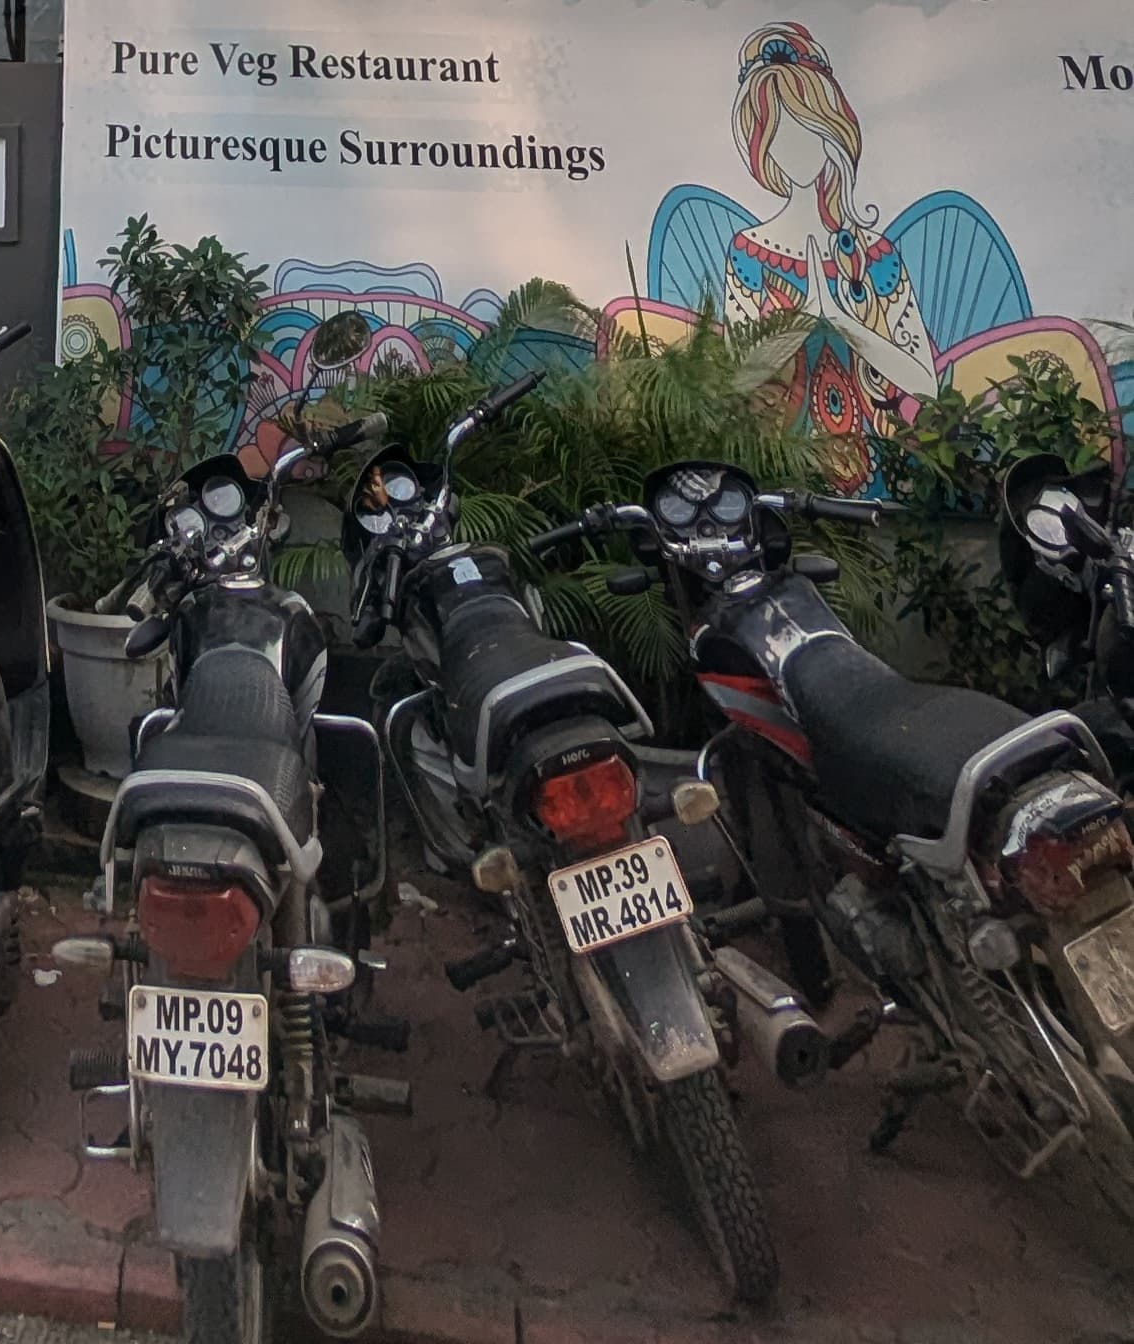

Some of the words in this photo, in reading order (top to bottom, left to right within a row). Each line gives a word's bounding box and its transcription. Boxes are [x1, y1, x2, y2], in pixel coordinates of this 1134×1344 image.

[112, 41, 199, 77] Pure
[210, 43, 278, 87] Veg
[289, 44, 501, 84] Restaurant
[1057, 55, 1134, 91] Mo
[104, 124, 328, 172] Picturesque
[339, 129, 607, 181] Surroundings
[574, 853, 649, 905] MP.39
[570, 881, 682, 947] MR.4814
[157, 994, 243, 1035] MP.09
[136, 1035, 262, 1081] MY.7048
